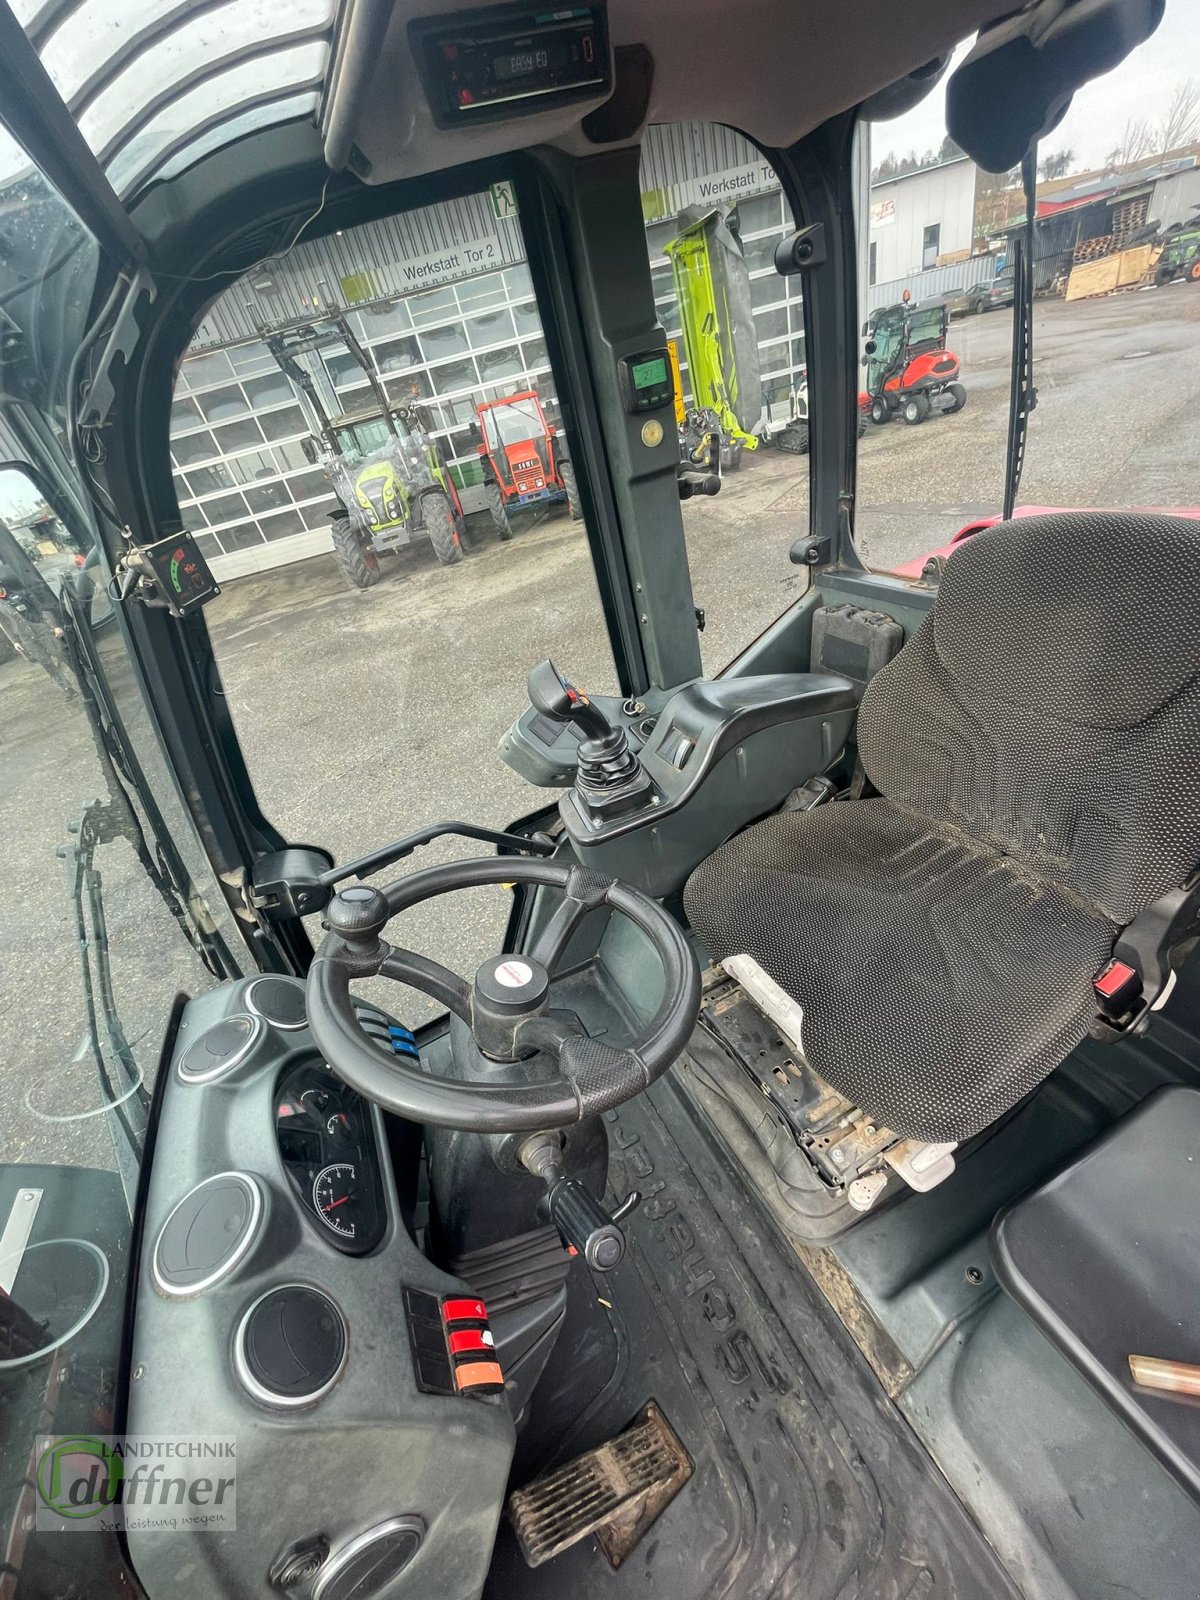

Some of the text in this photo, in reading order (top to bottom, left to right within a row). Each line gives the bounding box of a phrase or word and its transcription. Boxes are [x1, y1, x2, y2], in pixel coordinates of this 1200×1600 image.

[699, 166, 776, 198] Werkstatt To
[403, 243, 494, 280] Werkstatt Tor 2
